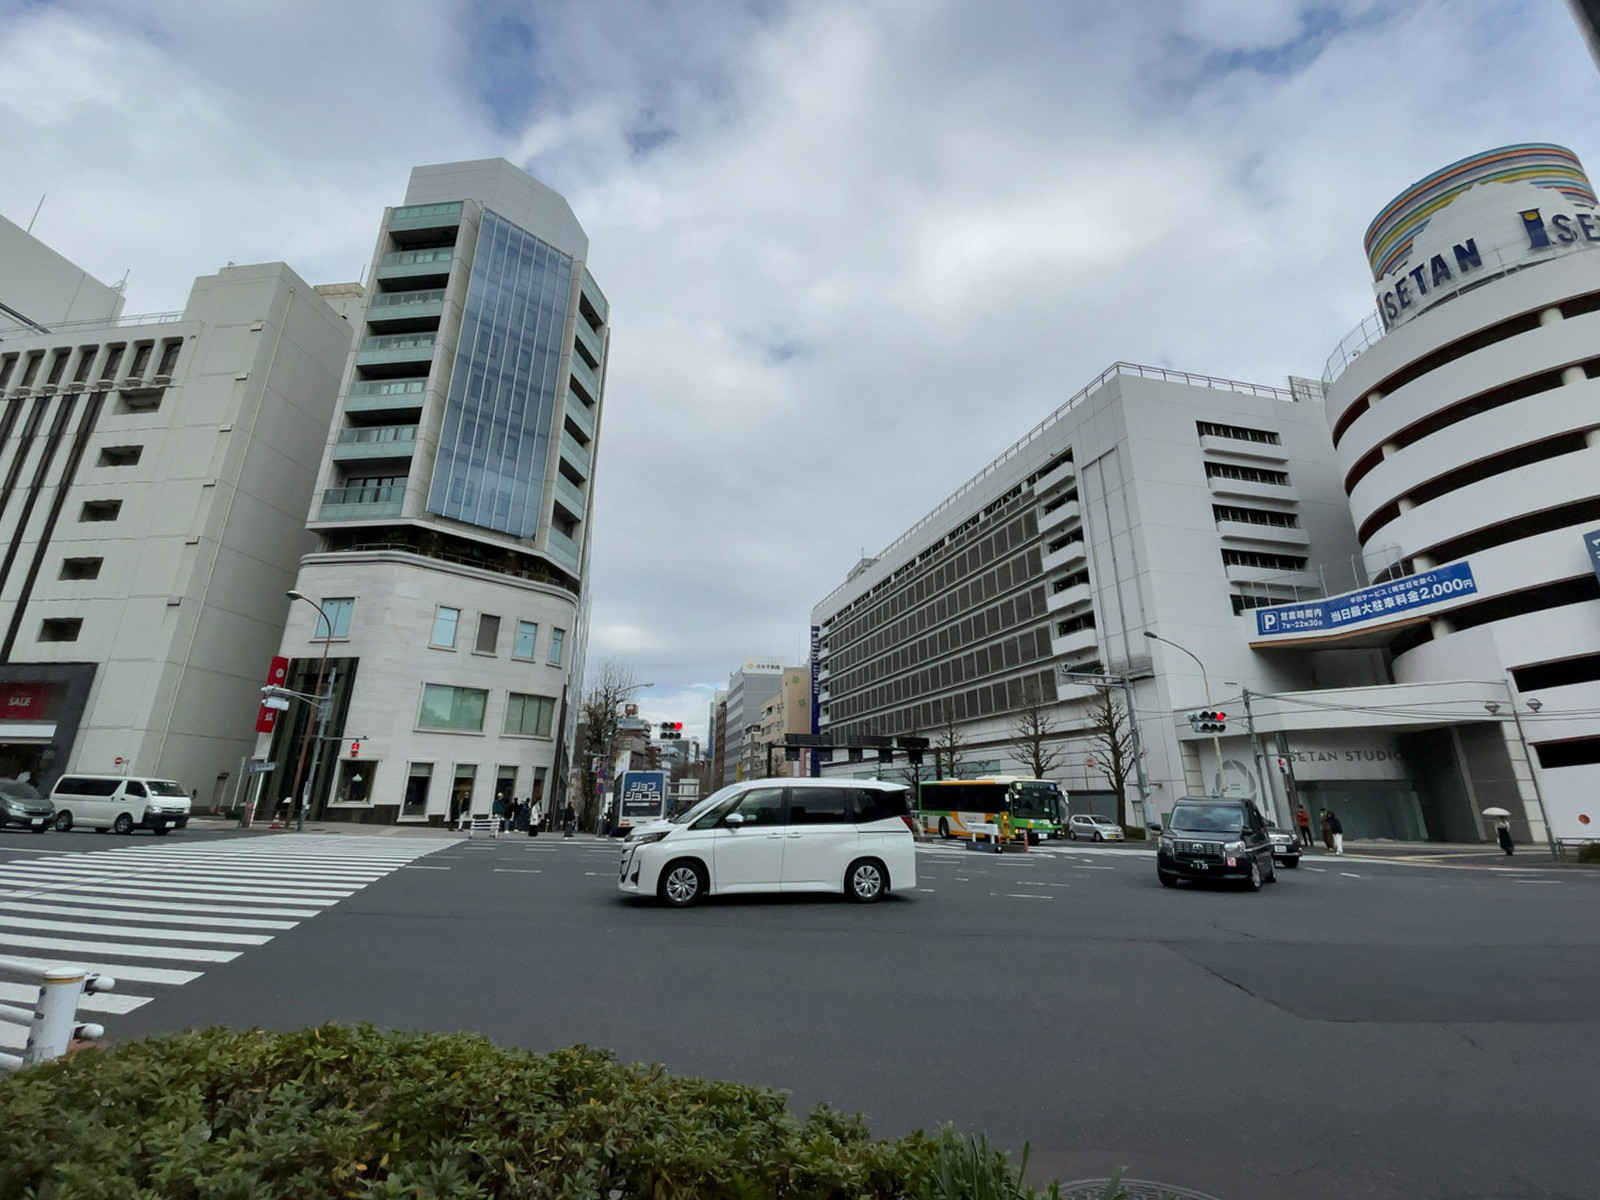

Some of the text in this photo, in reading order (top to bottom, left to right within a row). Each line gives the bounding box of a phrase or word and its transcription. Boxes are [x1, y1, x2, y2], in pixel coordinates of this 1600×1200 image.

[1375, 237, 1483, 335] ISETAN
[1264, 614, 1276, 630] P
[8, 697, 31, 706] SALE
